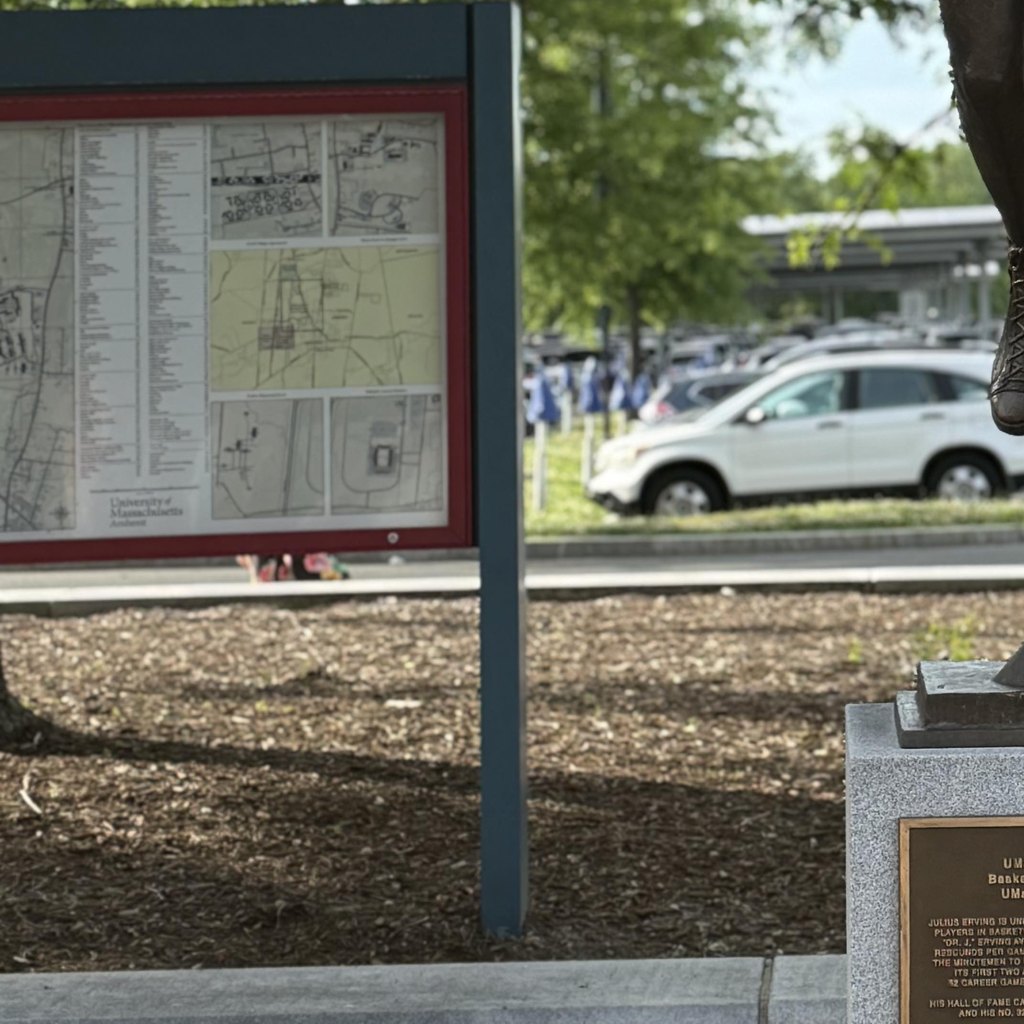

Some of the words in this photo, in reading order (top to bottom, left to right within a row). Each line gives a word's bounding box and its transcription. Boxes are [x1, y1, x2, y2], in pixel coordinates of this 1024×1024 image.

[928, 918, 959, 927] JULIUS
[962, 918, 996, 926] ERVING
[934, 928, 974, 937] PLAYERS
[978, 938, 1011, 946] ERVING
[934, 948, 984, 958] REBOUNDS
[986, 948, 1004, 956] PER
[932, 959, 950, 967] THE
[954, 958, 1006, 966] MINUTEMEN
[1009, 958, 1020, 966] TO
[954, 968, 968, 977] ITS
[972, 968, 998, 976] FIRST
[1000, 968, 1020, 976] TWO
[961, 978, 998, 987] CAREER
[929, 1000, 944, 1008] HIS
[948, 999, 970, 1008] HALL
[972, 998, 984, 1006] OF
[987, 998, 1011, 1006] FAME
[958, 1009, 978, 1018] AND
[980, 1009, 996, 1017] HIS
[998, 1008, 1014, 1017] NO.
